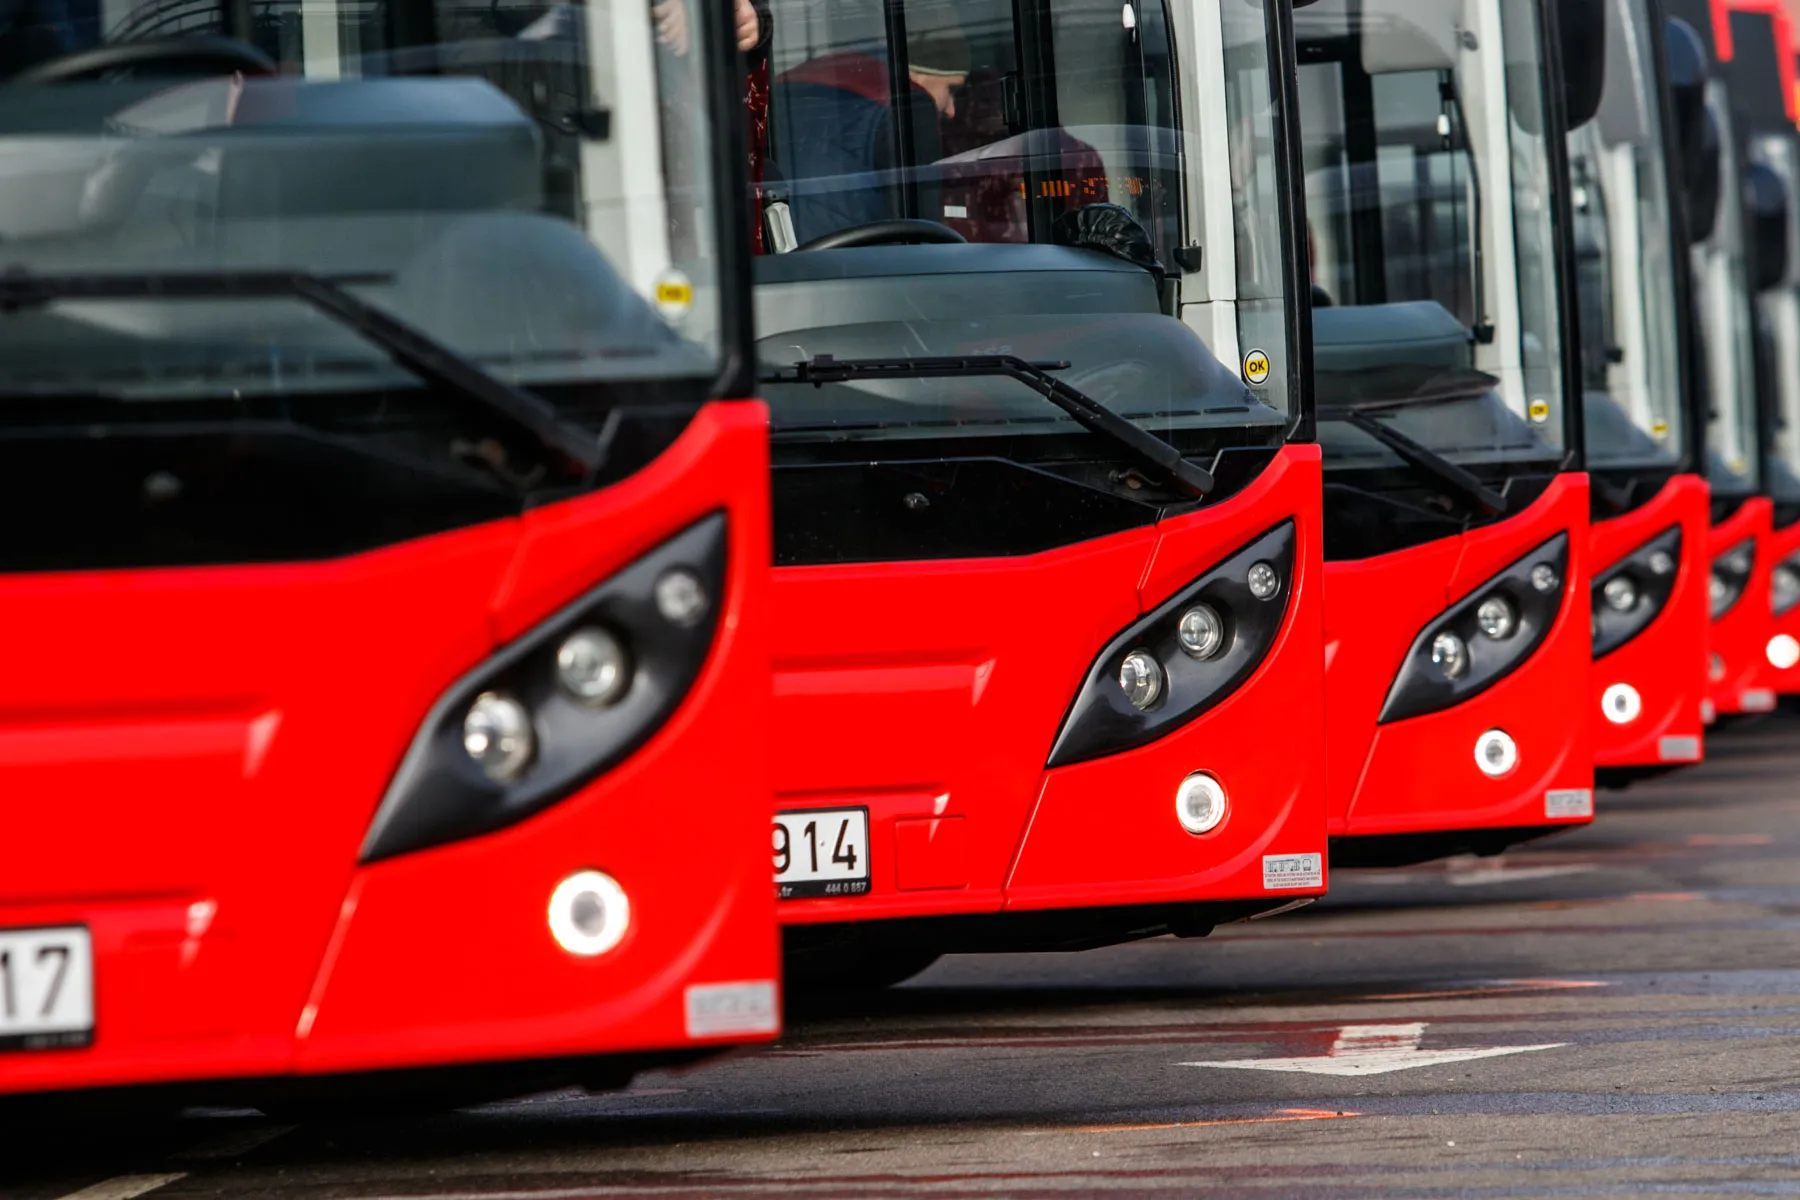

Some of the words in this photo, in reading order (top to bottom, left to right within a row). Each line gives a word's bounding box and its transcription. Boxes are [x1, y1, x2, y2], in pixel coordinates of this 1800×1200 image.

[1249, 360, 1265, 373] OK
[772, 819, 857, 875] 914
[825, 883, 841, 894] 444
[0, 946, 69, 1018] 17
